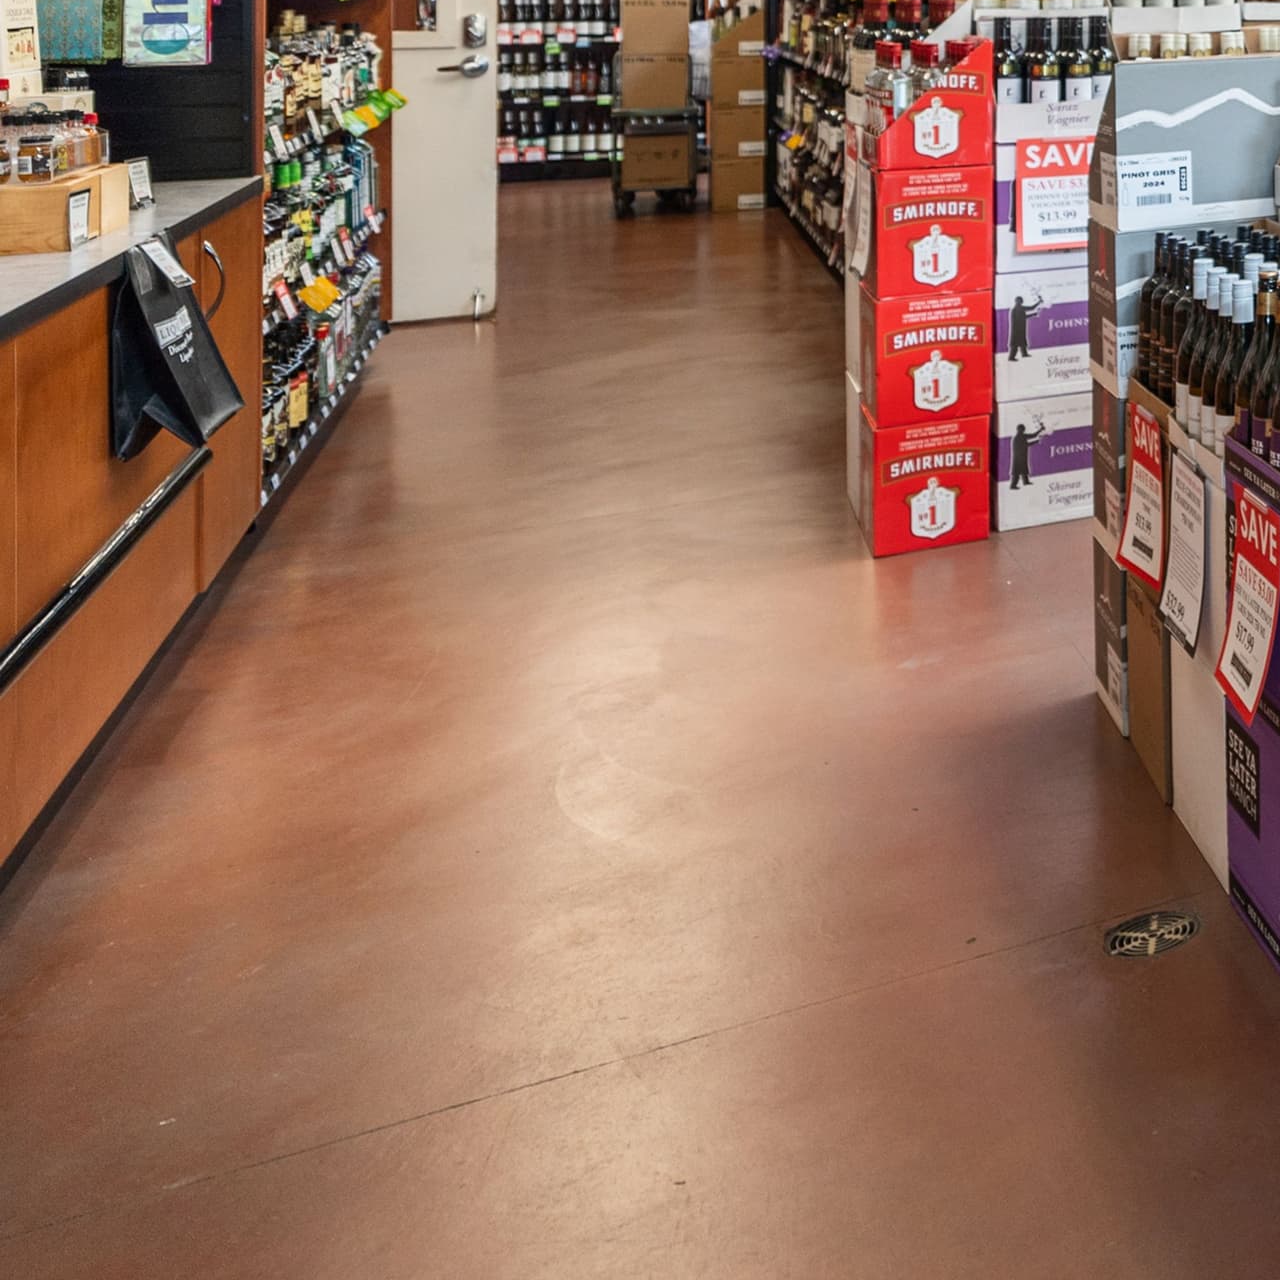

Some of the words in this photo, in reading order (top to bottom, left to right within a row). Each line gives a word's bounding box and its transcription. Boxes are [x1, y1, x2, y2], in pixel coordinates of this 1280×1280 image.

[1121, 170, 1151, 179] PINOT
[1152, 168, 1176, 178] GRIS
[1142, 180, 1165, 188] 2024
[892, 202, 977, 222] SMIRNOFF
[1038, 210, 1077, 222] $13.99
[893, 326, 977, 350] SMIRNOFF
[1239, 499, 1278, 567] SAVE
[1235, 620, 1254, 654] $17.99
[1227, 757, 1258, 797] LATER
